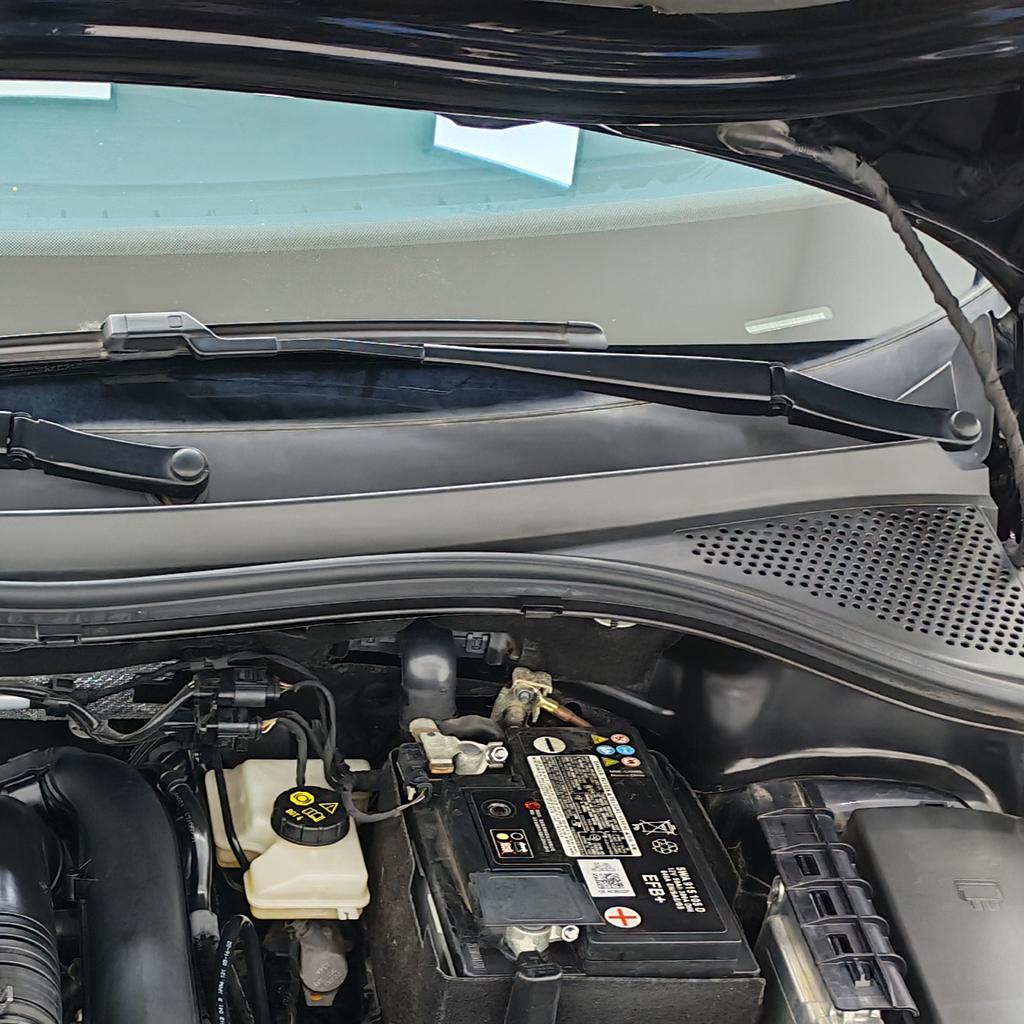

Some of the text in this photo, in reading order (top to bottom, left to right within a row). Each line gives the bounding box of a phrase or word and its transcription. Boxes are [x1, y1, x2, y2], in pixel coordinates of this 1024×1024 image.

[675, 866, 691, 880] 5WA
[642, 874, 666, 904] EFB+
[682, 881, 697, 893] 915
[688, 895, 703, 906] 105
